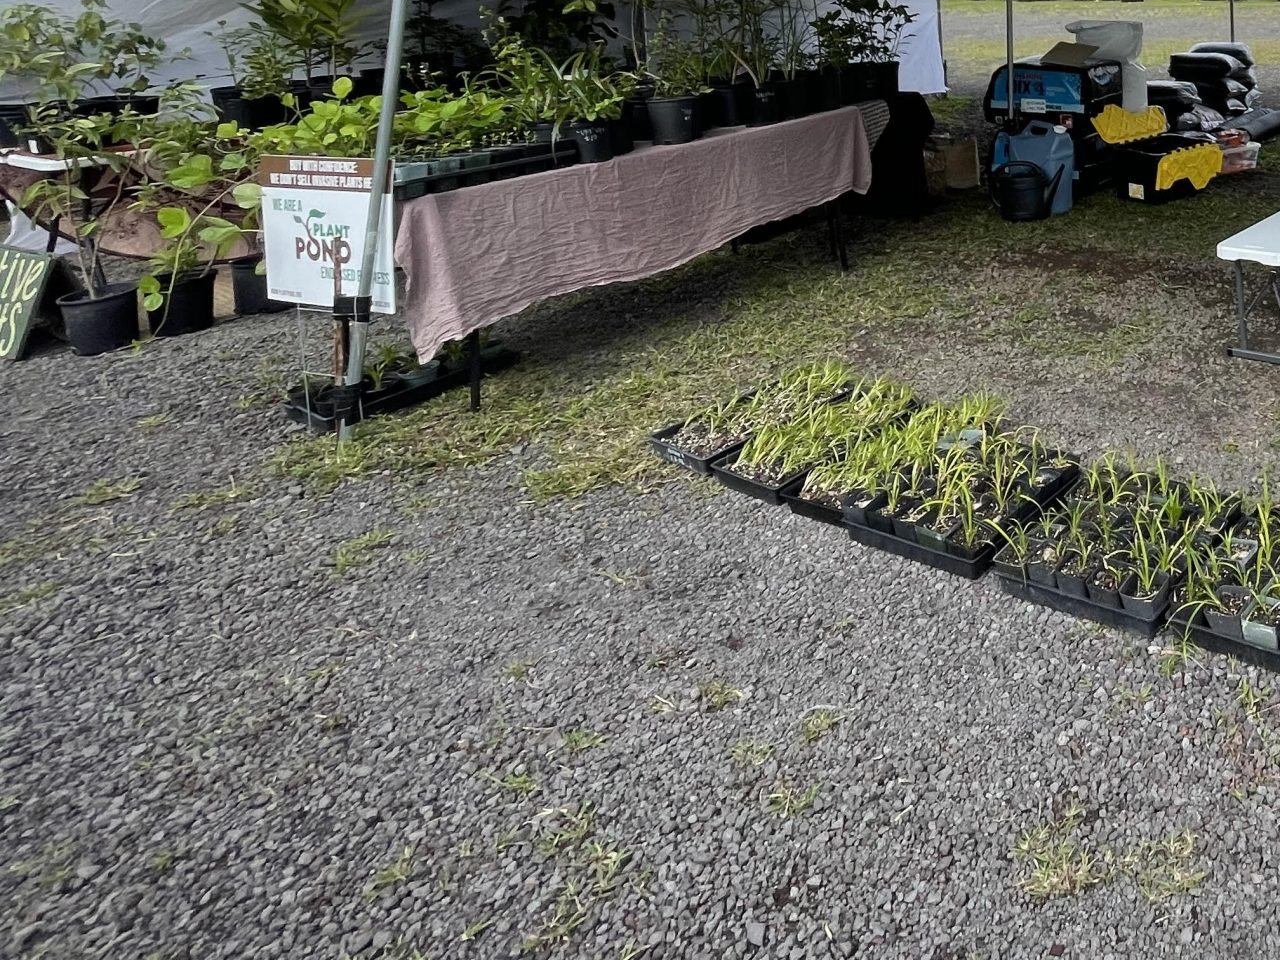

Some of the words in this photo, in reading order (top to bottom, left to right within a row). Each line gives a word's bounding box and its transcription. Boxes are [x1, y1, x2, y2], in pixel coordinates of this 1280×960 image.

[297, 174, 312, 186] SELL
[339, 176, 363, 188] PLANTS
[273, 198, 282, 211] WE
[284, 199, 296, 212] ARE
[298, 200, 303, 212] A
[313, 223, 350, 238] PLANT
[295, 236, 351, 264] PONO
